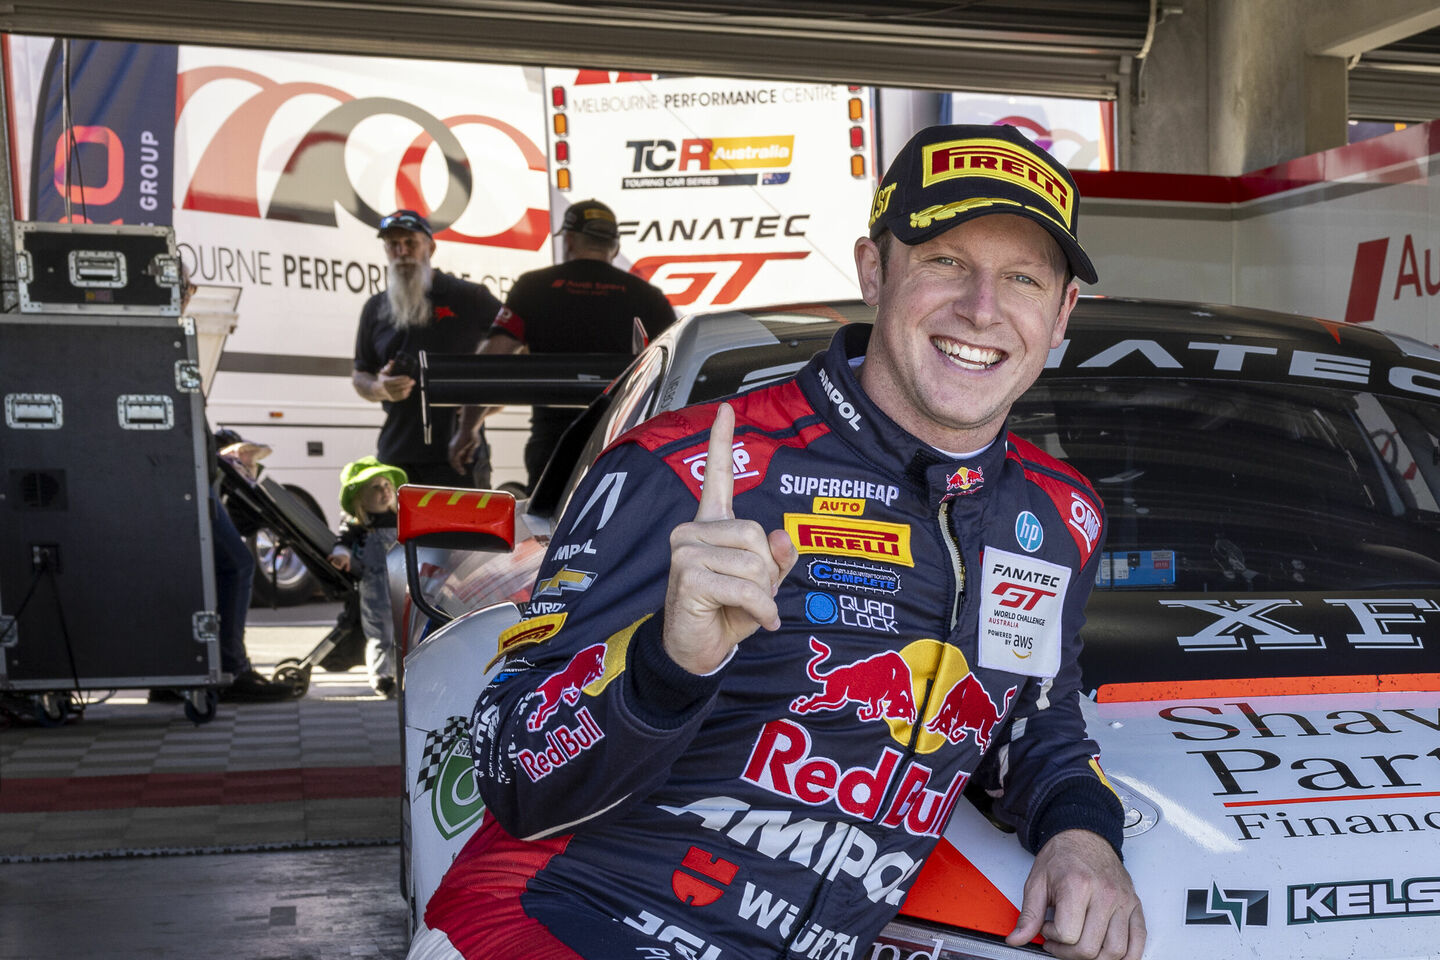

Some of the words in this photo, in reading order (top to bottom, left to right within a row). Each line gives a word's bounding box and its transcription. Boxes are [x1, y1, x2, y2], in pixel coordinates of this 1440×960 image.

[573, 94, 658, 113] MELBOURNE
[664, 89, 777, 109] PERFORMANCE
[782, 86, 838, 103] CENTRE
[625, 138, 713, 172] TCR
[713, 145, 790, 160] Australia
[140, 131, 159, 211] GROUP
[624, 178, 664, 188] TOURING
[665, 178, 685, 187] CAR
[685, 177, 719, 187] SERIES
[931, 145, 1068, 211] PIRELLI
[617, 214, 811, 242] FANATEC
[628, 251, 812, 307] GT
[818, 367, 861, 432] AMPOL
[690, 448, 751, 482] OP
[780, 473, 900, 507] SUPERCHEAP
[819, 500, 861, 514] AUTO
[1071, 499, 1099, 543] OMP
[798, 524, 900, 557] PIRELLI
[1020, 517, 1040, 546] hp
[813, 564, 896, 590] COMPLETE
[992, 563, 1060, 588] FANATEC
[839, 594, 894, 619] QUAD
[991, 582, 1057, 611] GT
[841, 609, 899, 634] LOCK
[988, 617, 1019, 629] AUSTRALIA
[993, 609, 1016, 620] WORLD
[1016, 613, 1046, 626] CHALLENGE
[987, 629, 1012, 639] POWERED
[1013, 634, 1034, 650] aws
[517, 731, 568, 783] Red
[554, 705, 606, 758] Bull
[741, 717, 904, 823] Red
